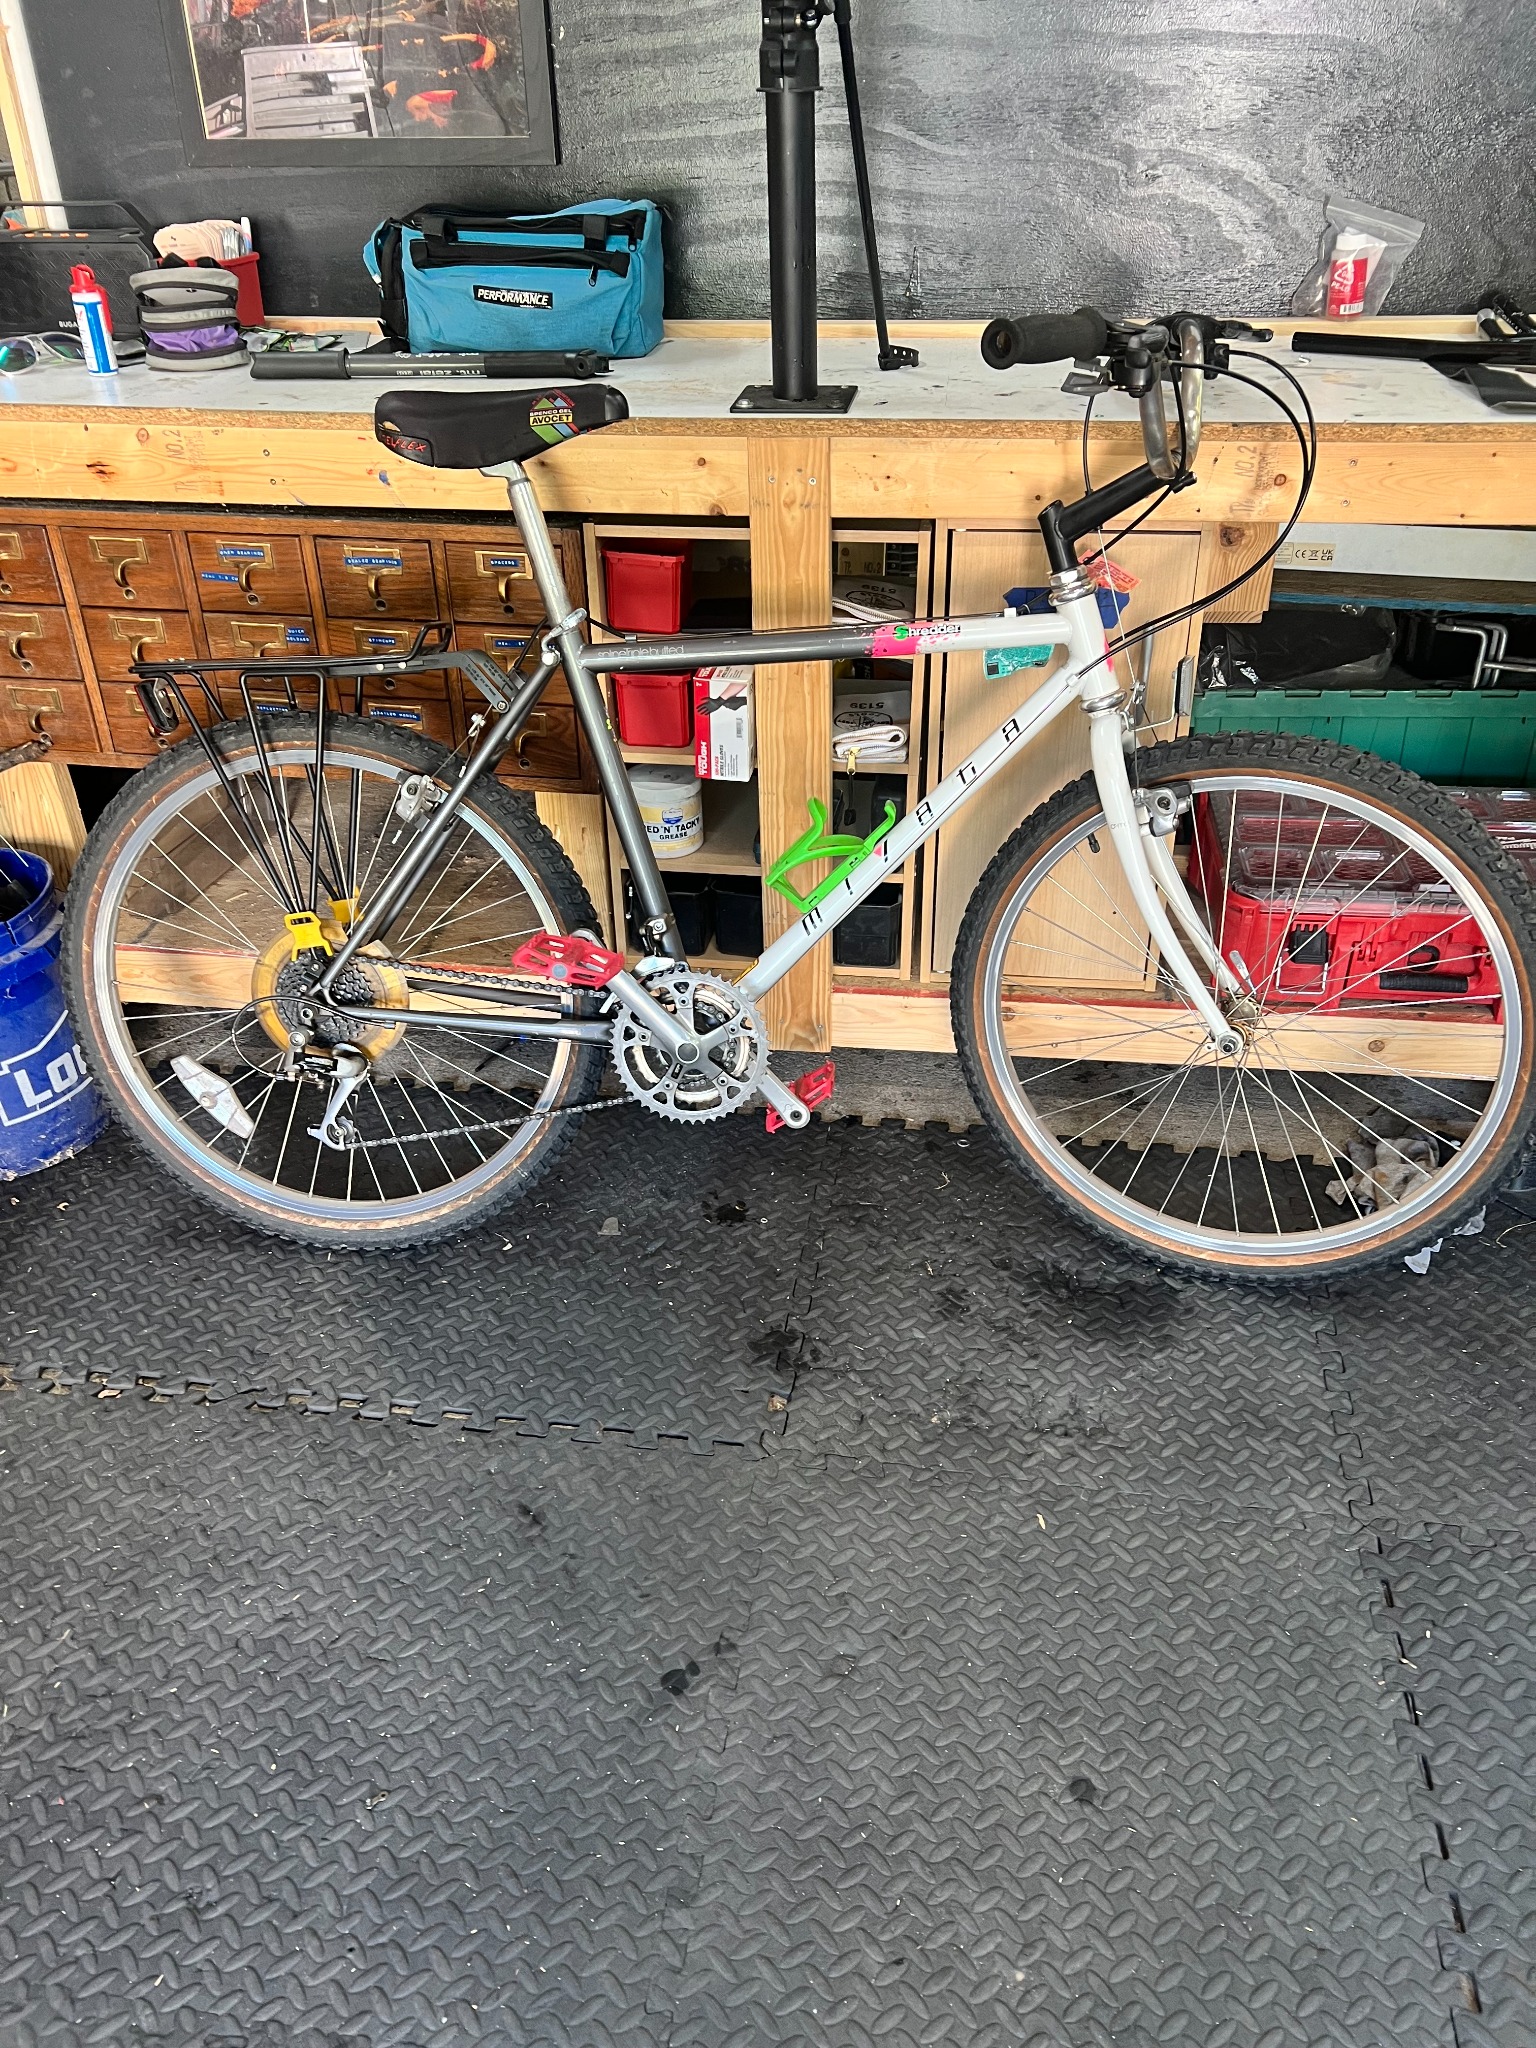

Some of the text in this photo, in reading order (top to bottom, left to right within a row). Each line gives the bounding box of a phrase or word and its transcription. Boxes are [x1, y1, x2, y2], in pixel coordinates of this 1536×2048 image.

[477, 288, 550, 306] PERFORMANCE
[58, 320, 80, 328] BUGA
[531, 414, 572, 425] AVOCET
[894, 624, 961, 641] Shredder
[700, 741, 708, 775] TOUGH
[646, 825, 660, 834] ED
[674, 816, 700, 832] TACKY
[659, 831, 688, 840] GREASE
